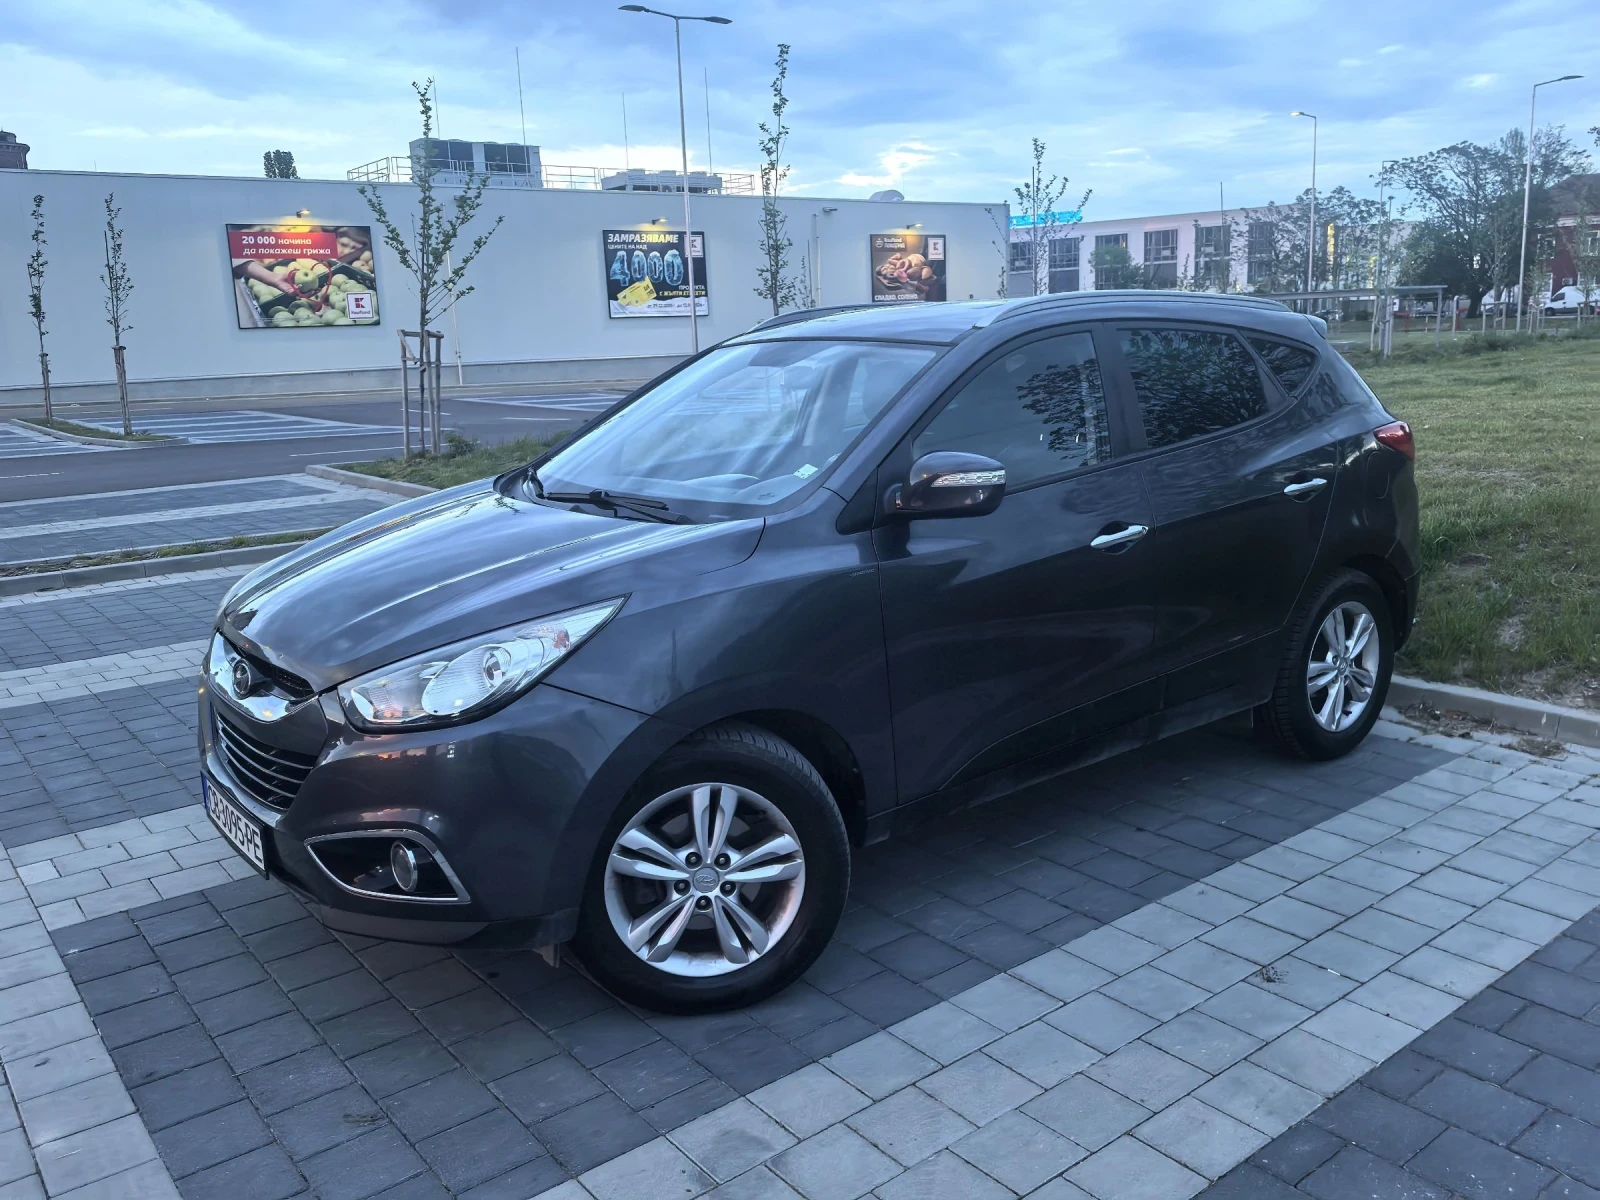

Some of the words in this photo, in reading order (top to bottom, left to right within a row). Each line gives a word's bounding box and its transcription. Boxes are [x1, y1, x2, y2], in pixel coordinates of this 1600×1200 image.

[242, 236, 255, 245] 20
[257, 236, 276, 245] 000
[607, 233, 679, 243] ЗАМРАЗЯВАМЕ
[243, 248, 256, 256] да
[303, 248, 331, 256] грижа
[610, 249, 684, 287] 4000
